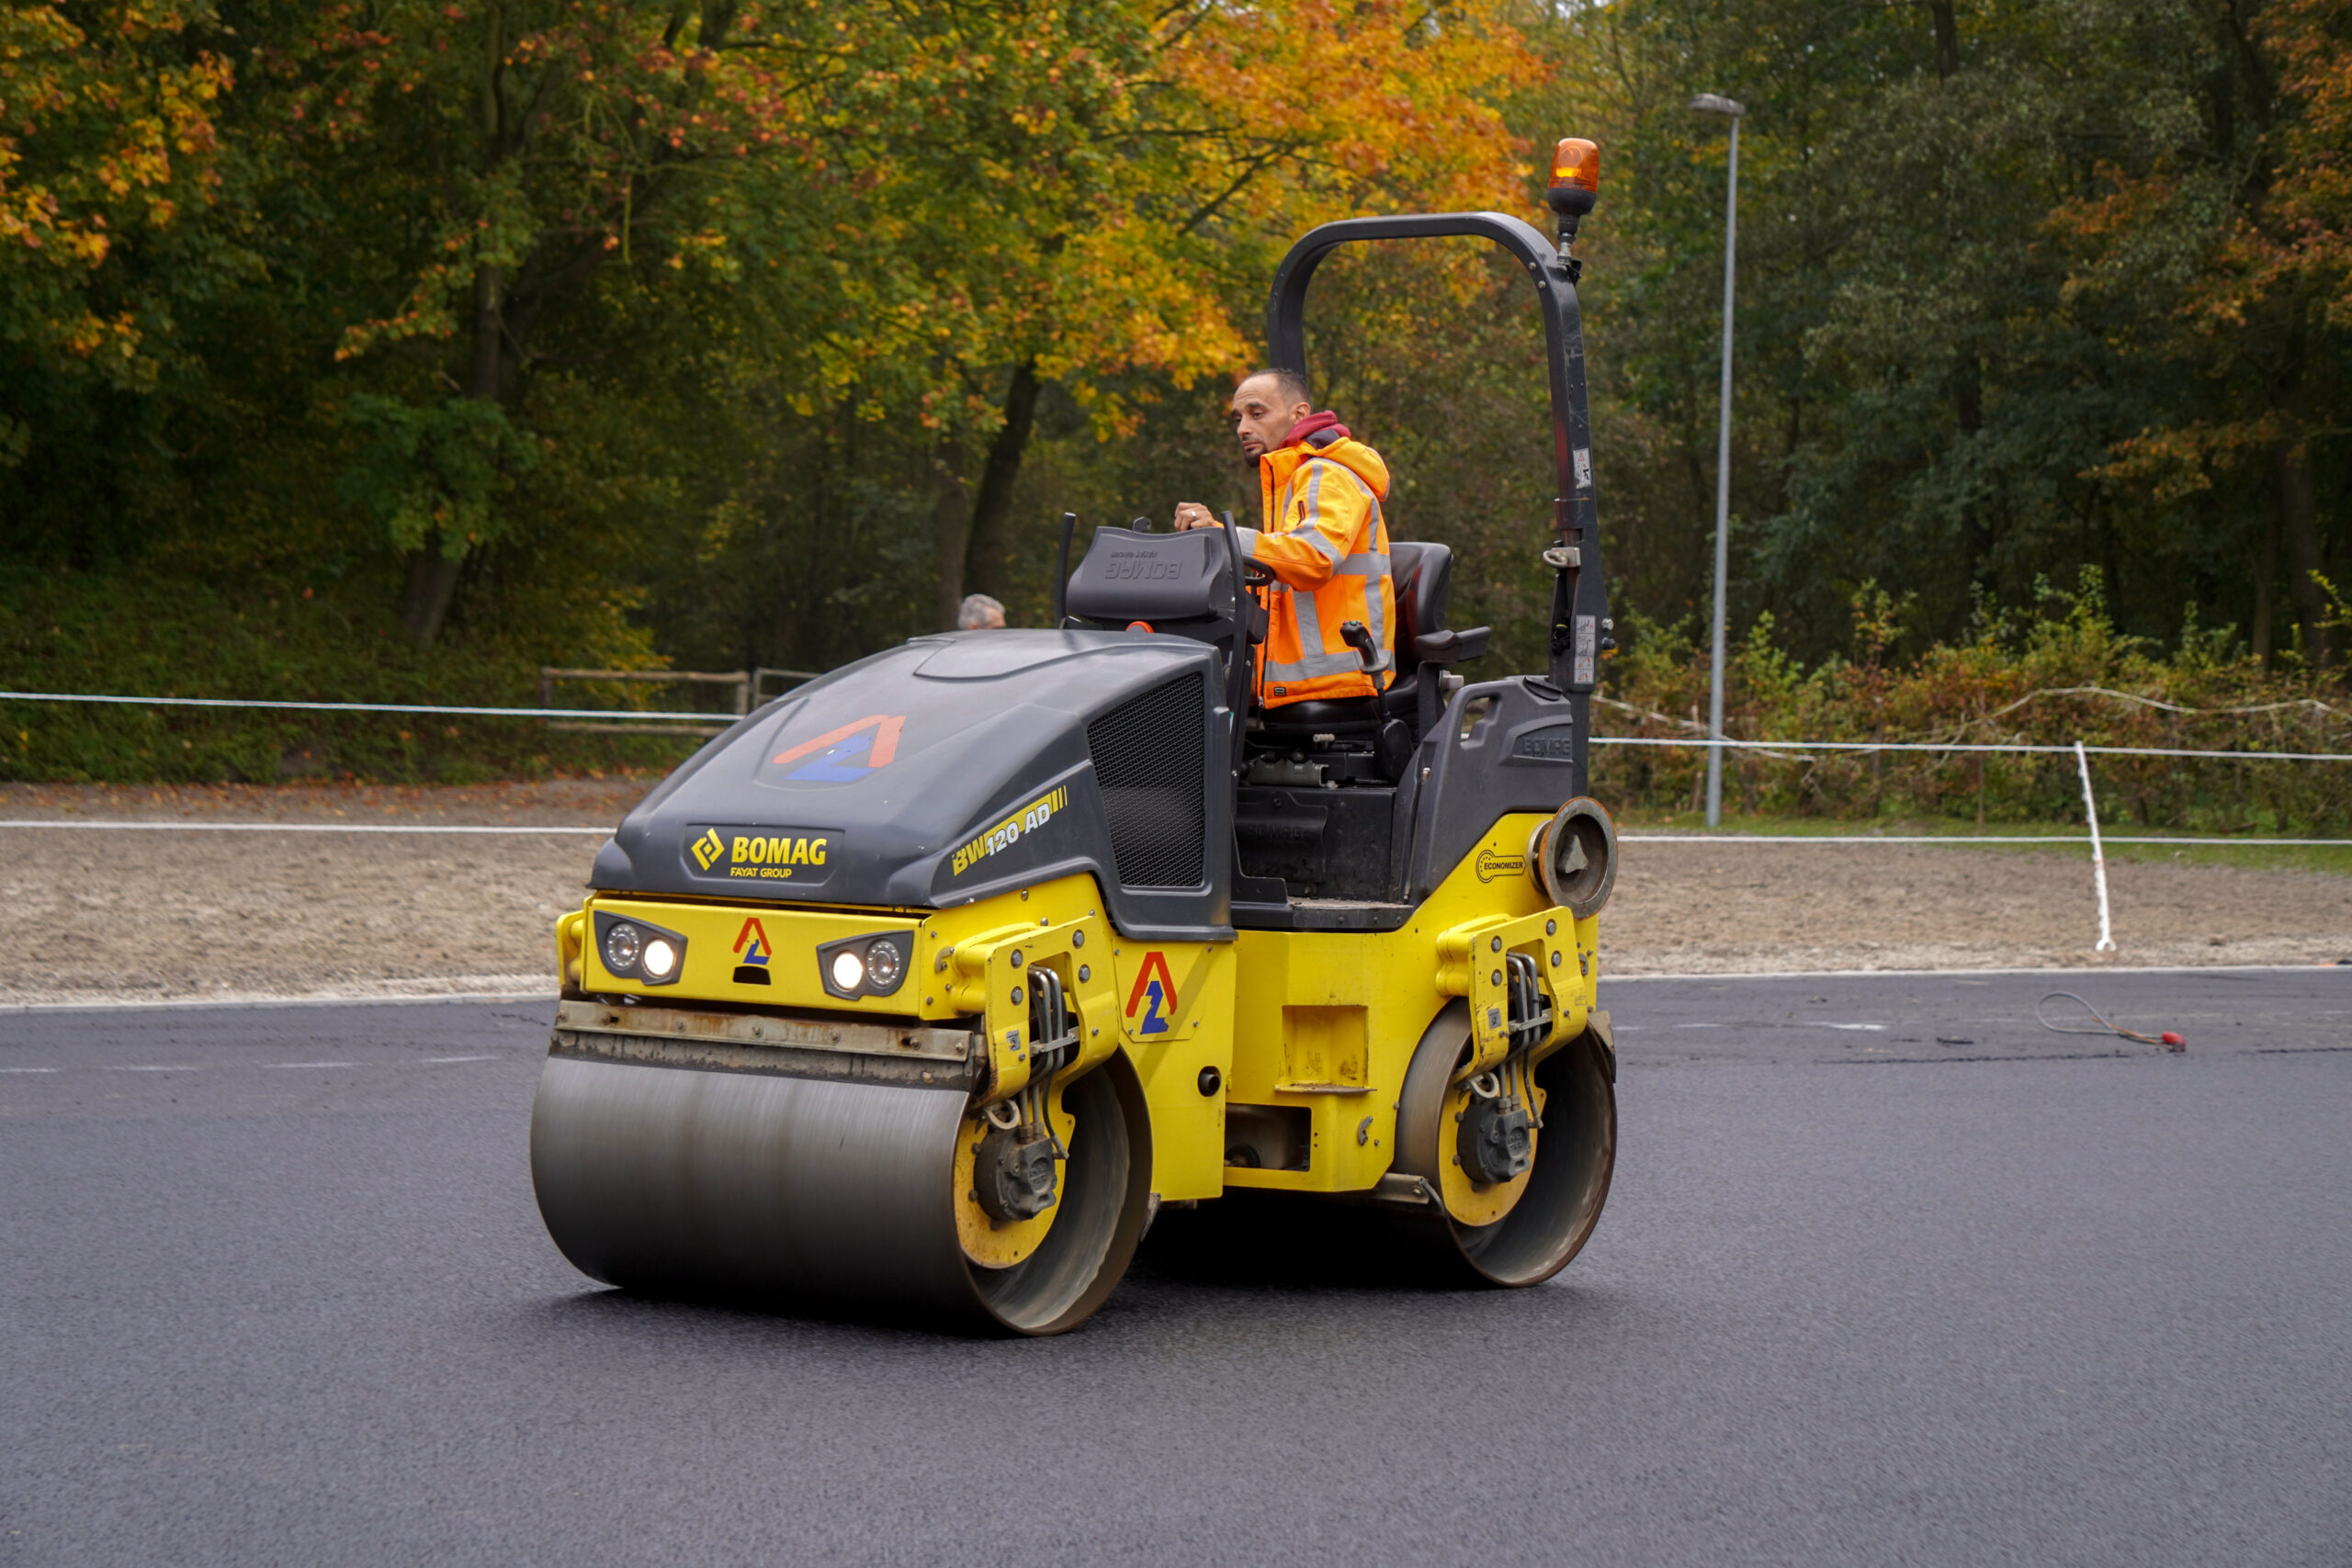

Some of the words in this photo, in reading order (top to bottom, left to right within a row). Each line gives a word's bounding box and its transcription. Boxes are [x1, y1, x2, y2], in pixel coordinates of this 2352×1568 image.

[952, 834, 987, 876] BW
[986, 821, 1019, 856] 120
[1024, 802, 1051, 834] AD
[731, 836, 827, 865] BOMAG
[729, 866, 759, 877] FAYAT
[760, 868, 793, 878] GROUP
[1484, 862, 1524, 870] ECONOMIZER
